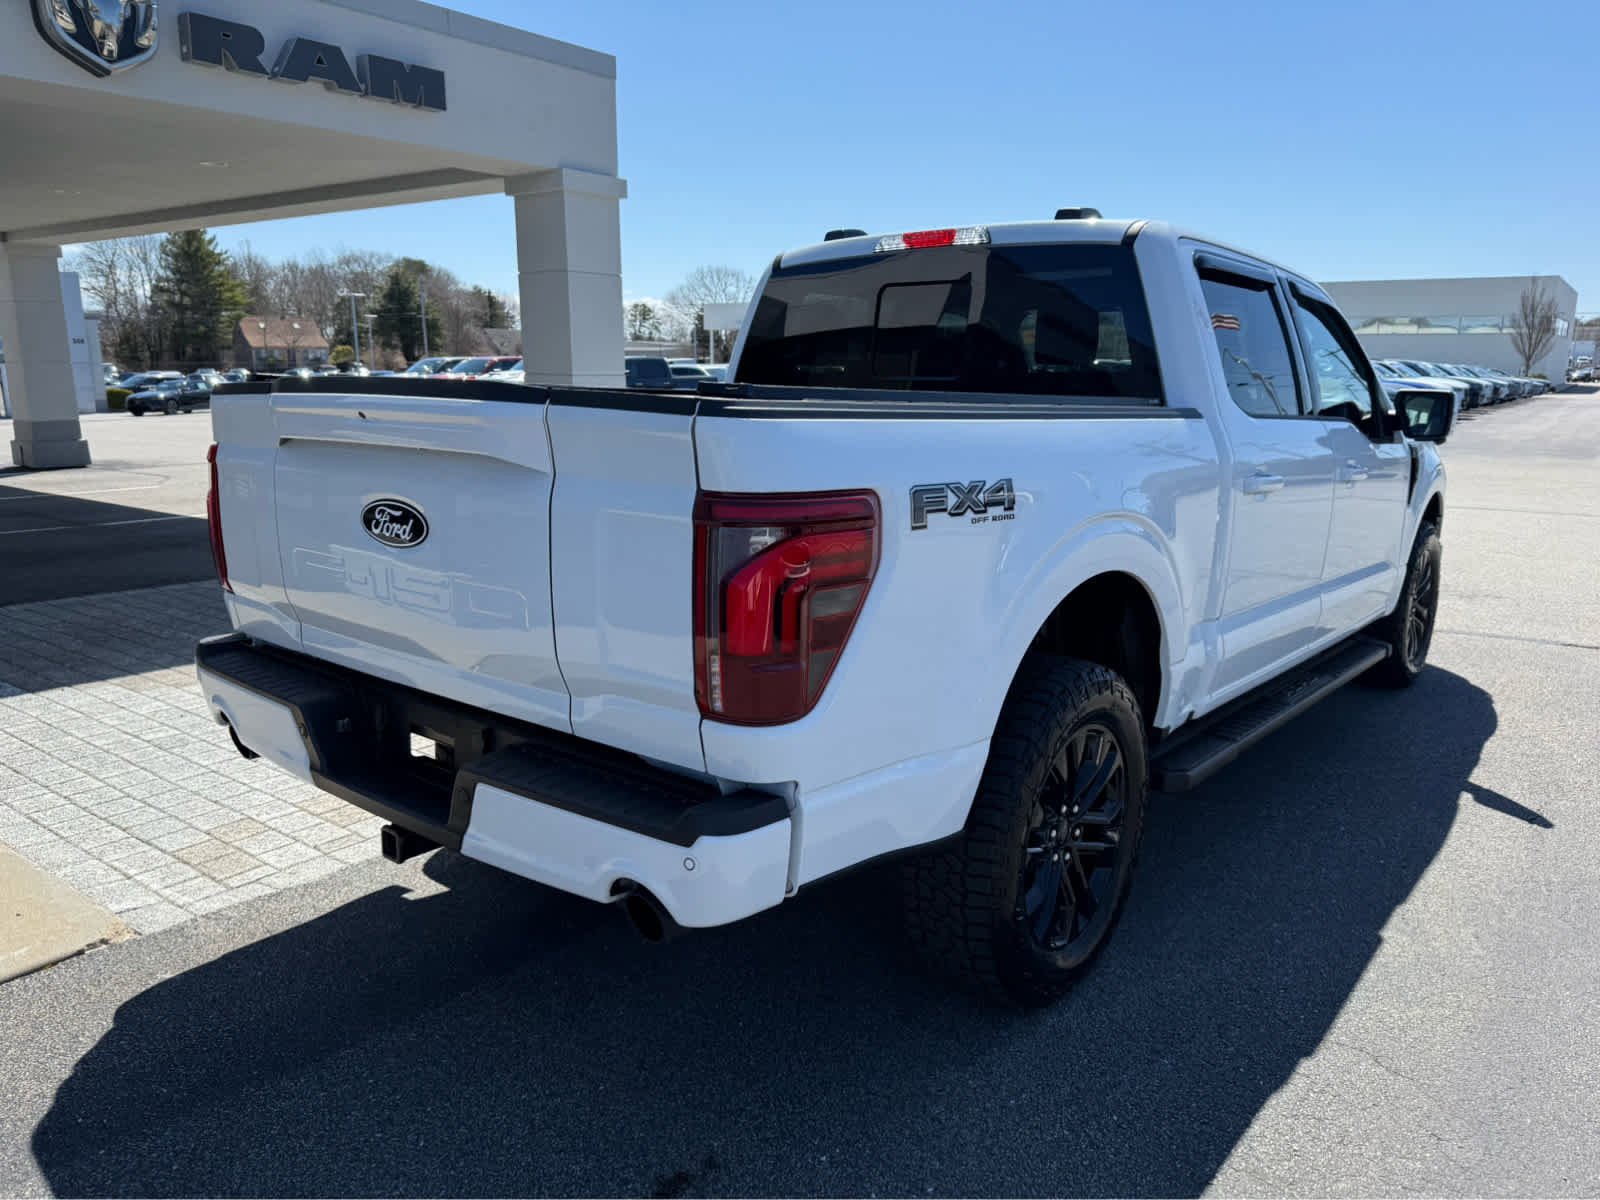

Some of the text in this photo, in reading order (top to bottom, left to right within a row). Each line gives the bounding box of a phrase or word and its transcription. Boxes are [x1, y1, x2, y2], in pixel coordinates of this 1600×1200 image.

[178, 11, 447, 112] RAM
[371, 506, 414, 541] Ford
[909, 478, 1015, 530] FX4
[971, 513, 1015, 525] OFF ROAD
